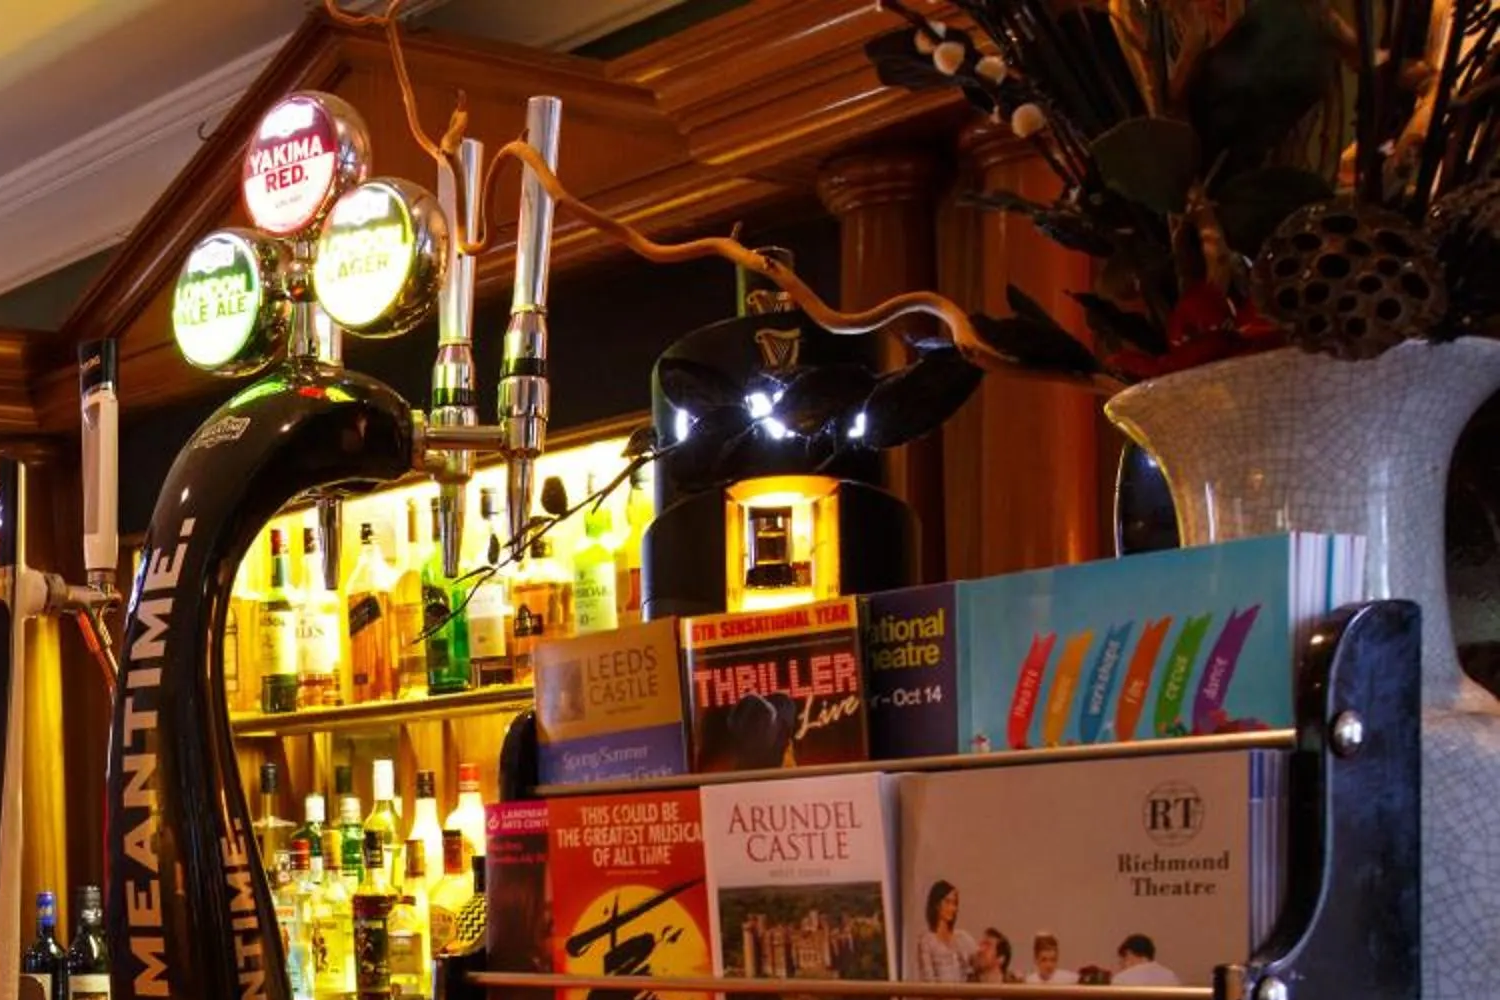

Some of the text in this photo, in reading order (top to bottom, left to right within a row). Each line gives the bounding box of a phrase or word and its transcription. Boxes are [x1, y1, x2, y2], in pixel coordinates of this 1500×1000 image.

[250, 134, 324, 176] YAKIMA
[265, 164, 309, 193] RED.
[720, 609, 810, 639] SENSATIONAL
[815, 603, 851, 625] YEAR
[869, 607, 946, 643] ational
[586, 644, 659, 683] LEEDS
[693, 653, 858, 708] THRILLER
[1089, 639, 1120, 715] workshops
[588, 673, 659, 705] CASTLE
[892, 687, 922, 706] Oct
[924, 685, 942, 704] 14
[794, 694, 860, 740] Live
[122, 516, 197, 998] MEANTIME.
[580, 802, 679, 825] THIS COULD BE
[728, 800, 862, 834] ARUNDEL
[1150, 797, 1202, 831] RT
[557, 822, 702, 848] THE GREATEST MUSICA
[746, 831, 850, 862] CASTLE
[593, 845, 672, 867] OF ALL TIME
[1117, 850, 1230, 874] Richmond
[1130, 876, 1217, 897] Theatre
